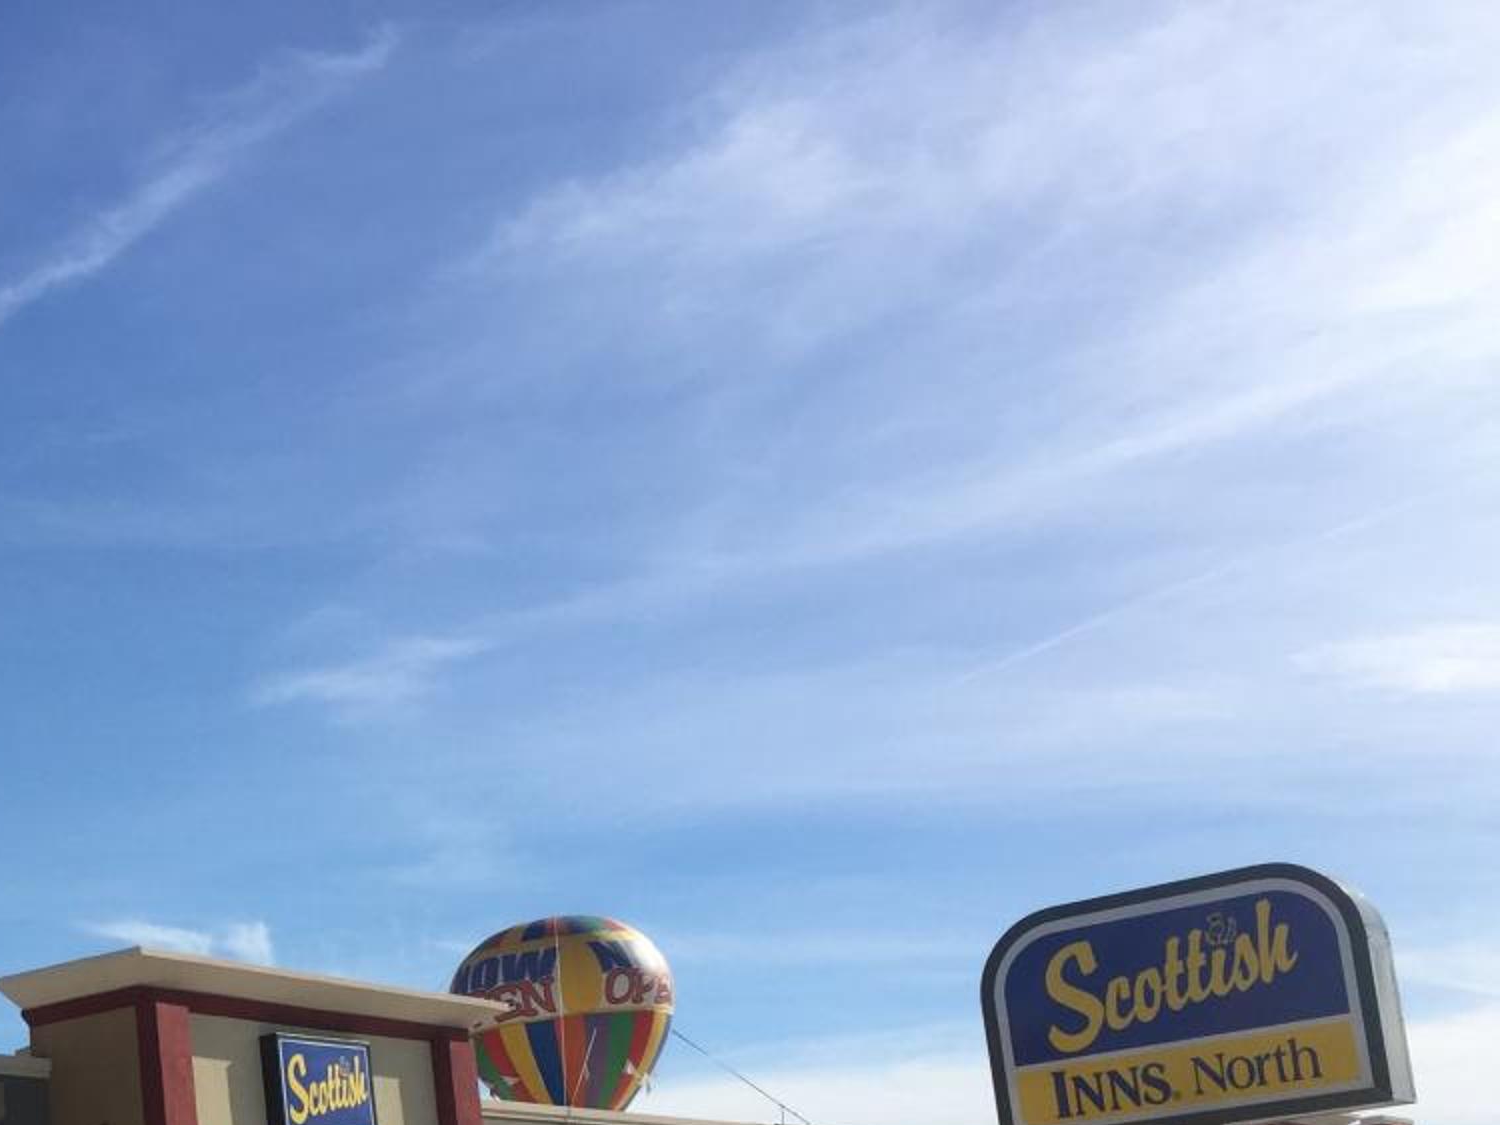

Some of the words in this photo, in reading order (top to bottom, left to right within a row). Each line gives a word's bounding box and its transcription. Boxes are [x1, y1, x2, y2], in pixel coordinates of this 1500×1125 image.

[1045, 898, 1298, 1054] Scottish
[287, 1053, 369, 1125] Scottish
[1191, 1037, 1323, 1095] North
